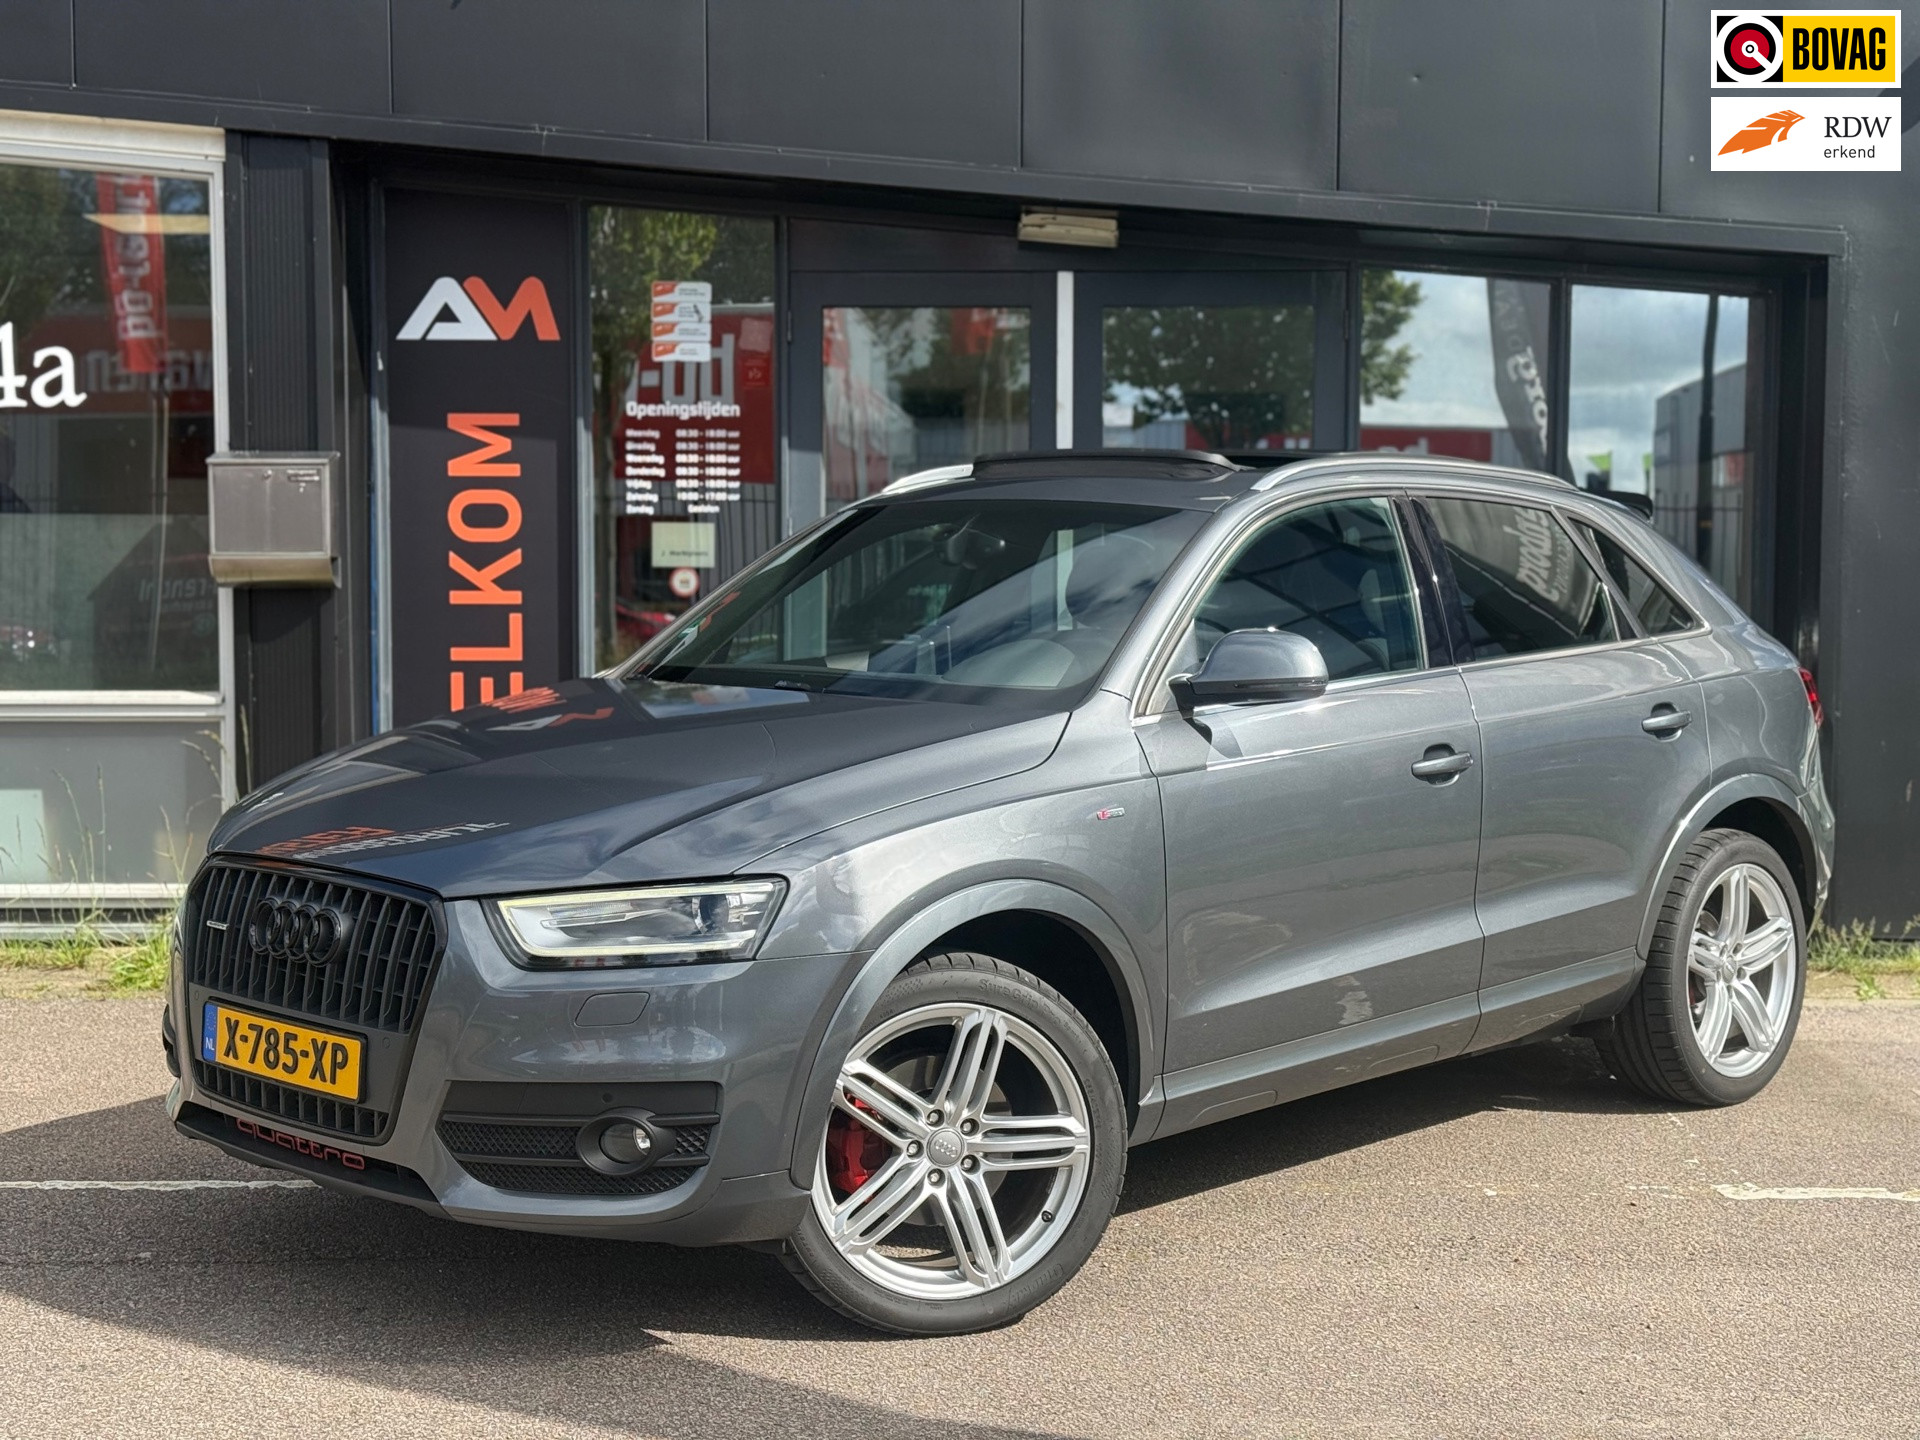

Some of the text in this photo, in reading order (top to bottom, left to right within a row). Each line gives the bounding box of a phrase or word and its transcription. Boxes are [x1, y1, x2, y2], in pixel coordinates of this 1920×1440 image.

[625, 401, 741, 420] Openingstijden
[205, 1039, 215, 1051] NL
[224, 1017, 349, 1085] X-785-XP
[236, 1117, 366, 1171] quattro
